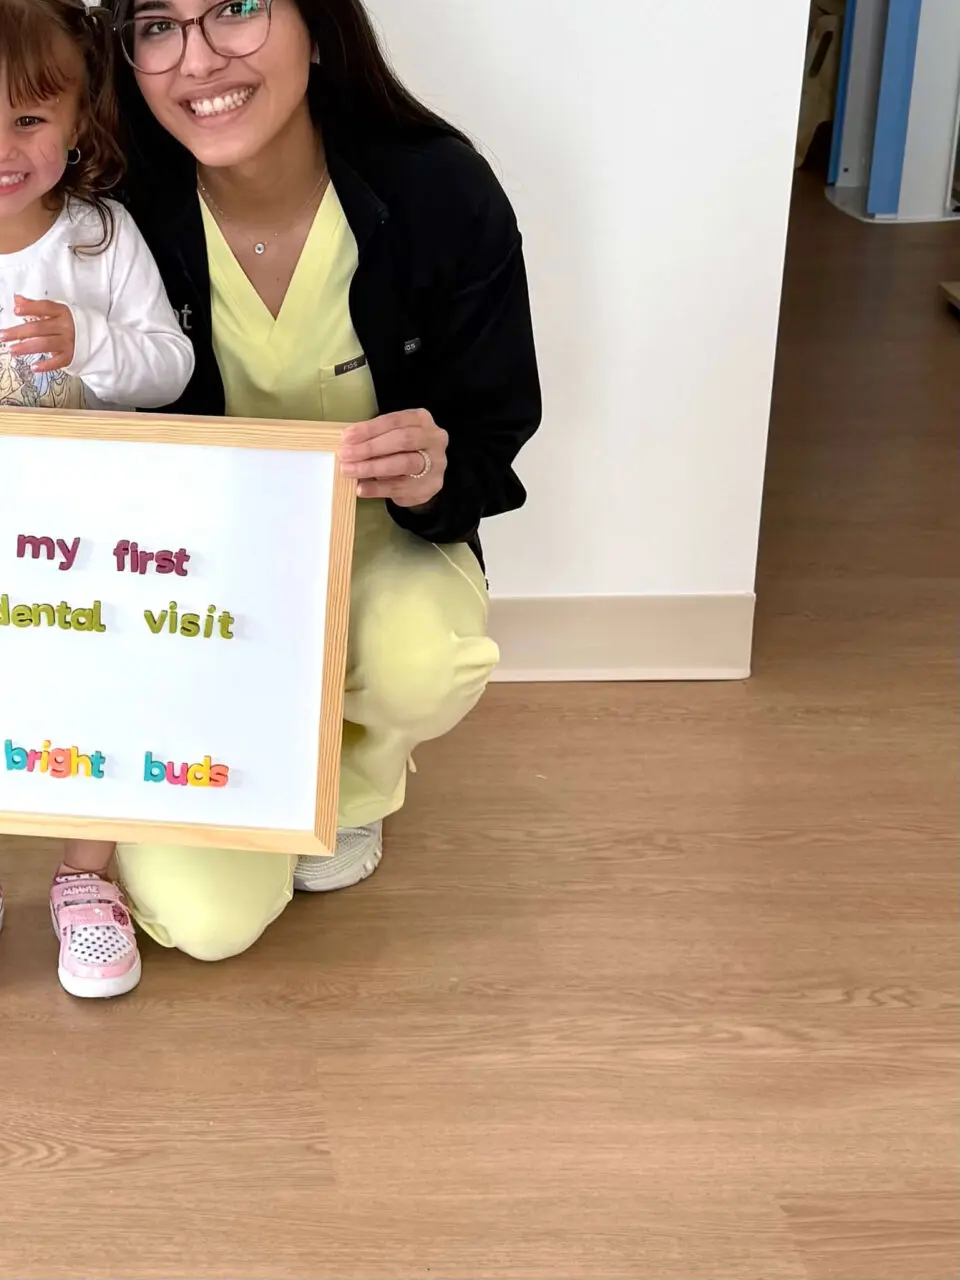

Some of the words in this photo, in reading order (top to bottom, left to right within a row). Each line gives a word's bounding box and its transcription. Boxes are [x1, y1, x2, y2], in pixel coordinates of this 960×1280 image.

[16, 534, 81, 571] my
[113, 540, 191, 577] first
[143, 601, 236, 640] visit
[3, 739, 107, 780] bright
[143, 751, 230, 788] buds
